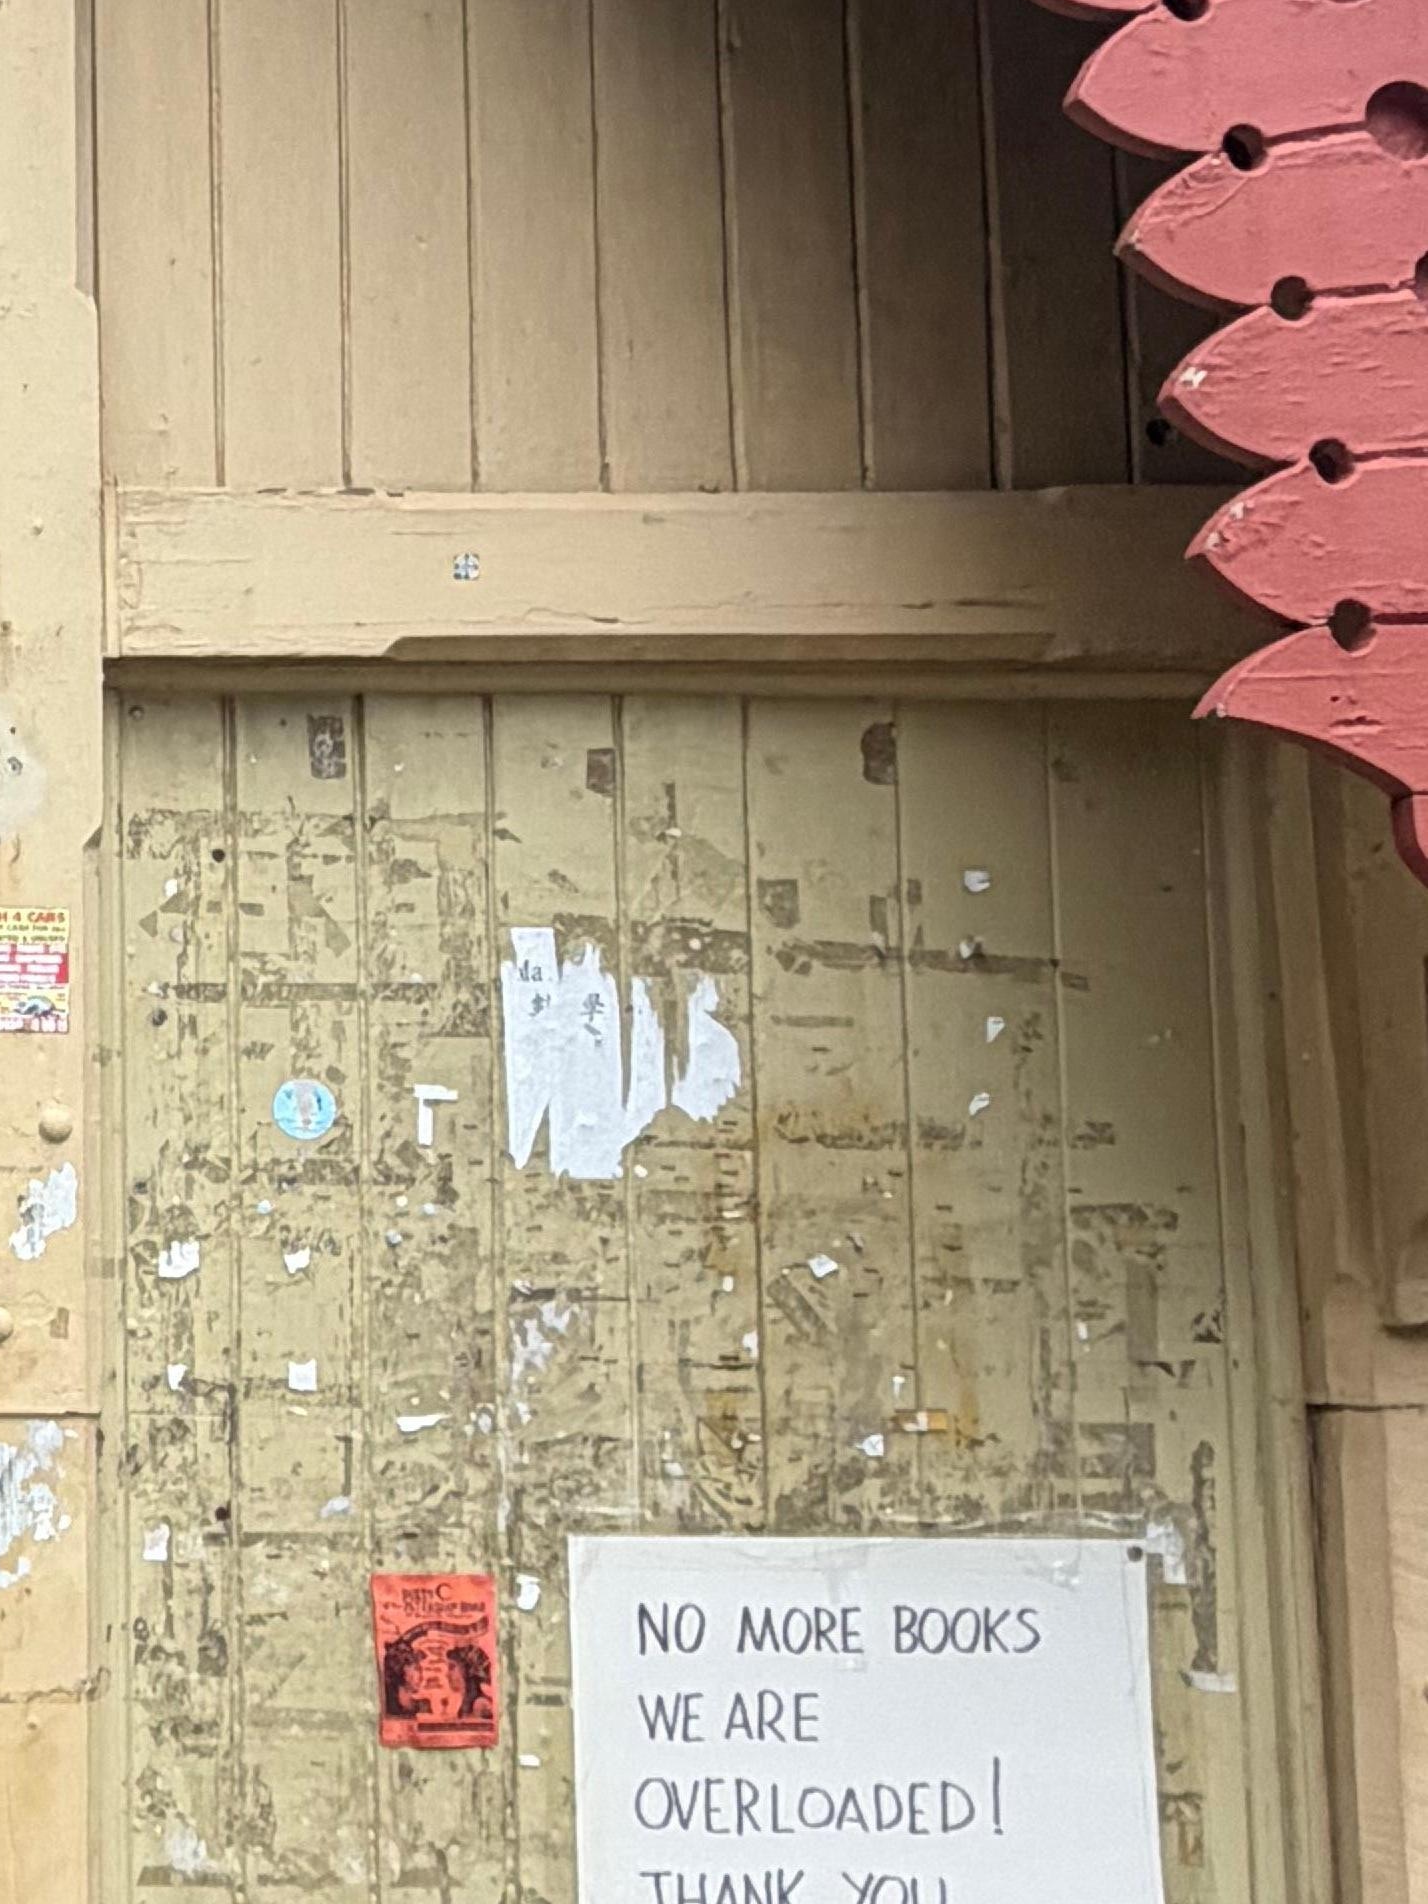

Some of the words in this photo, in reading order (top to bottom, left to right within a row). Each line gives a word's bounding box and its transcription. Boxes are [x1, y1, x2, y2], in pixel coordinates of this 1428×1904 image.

[13, 911, 21, 922] 4
[27, 912, 65, 923] CARS
[639, 1603, 706, 1656] NO
[737, 1606, 864, 1655] MORE
[893, 1605, 1041, 1655] BOOKS
[638, 1692, 704, 1742] WE
[724, 1689, 819, 1742] ARE
[635, 1756, 1004, 1836] OVERLOADED!
